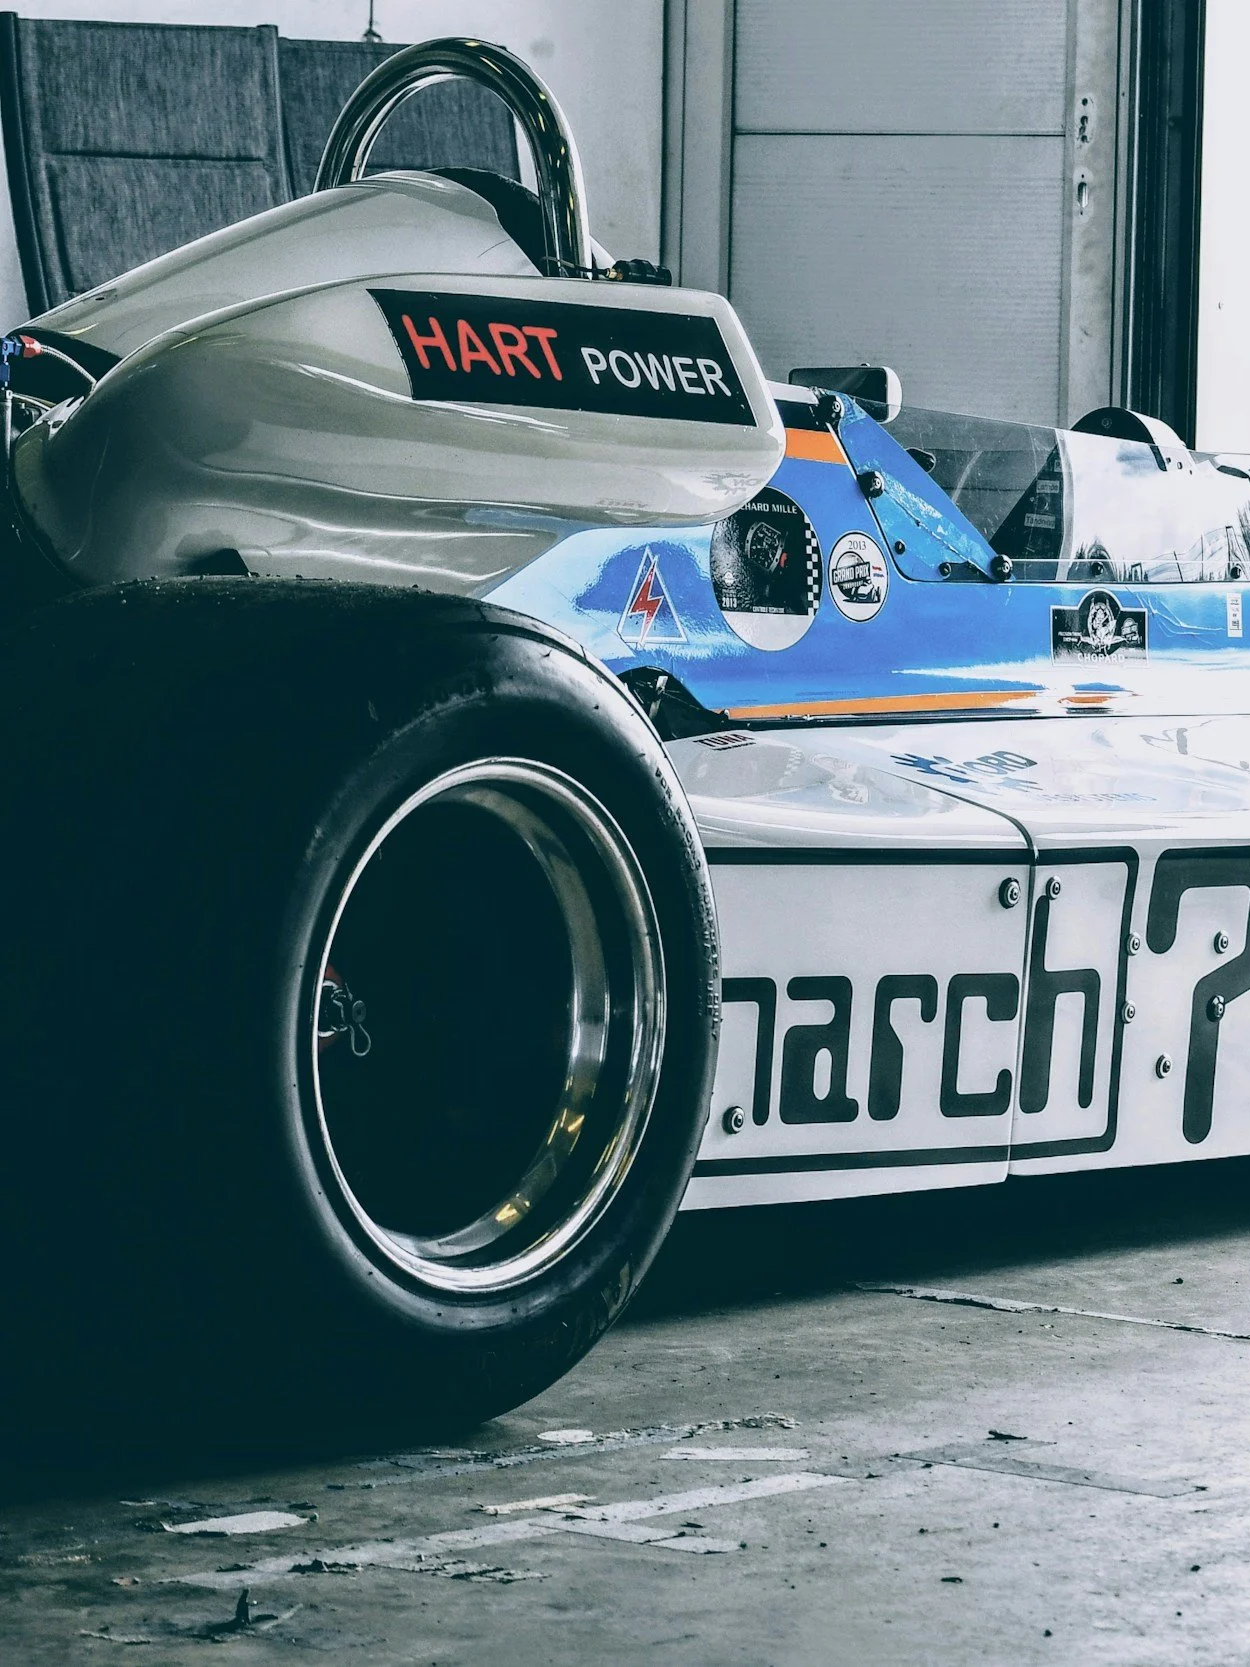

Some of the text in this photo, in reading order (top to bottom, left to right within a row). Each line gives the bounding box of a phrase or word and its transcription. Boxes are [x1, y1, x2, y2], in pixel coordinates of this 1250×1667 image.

[402, 314, 732, 397] HART POWER
[771, 503, 798, 514] MILLE
[848, 540, 867, 551] 2013
[833, 567, 855, 584] GRAND
[722, 597, 738, 608] 2013
[1077, 652, 1125, 664] CHOPARD
[692, 733, 755, 747] TUNA
